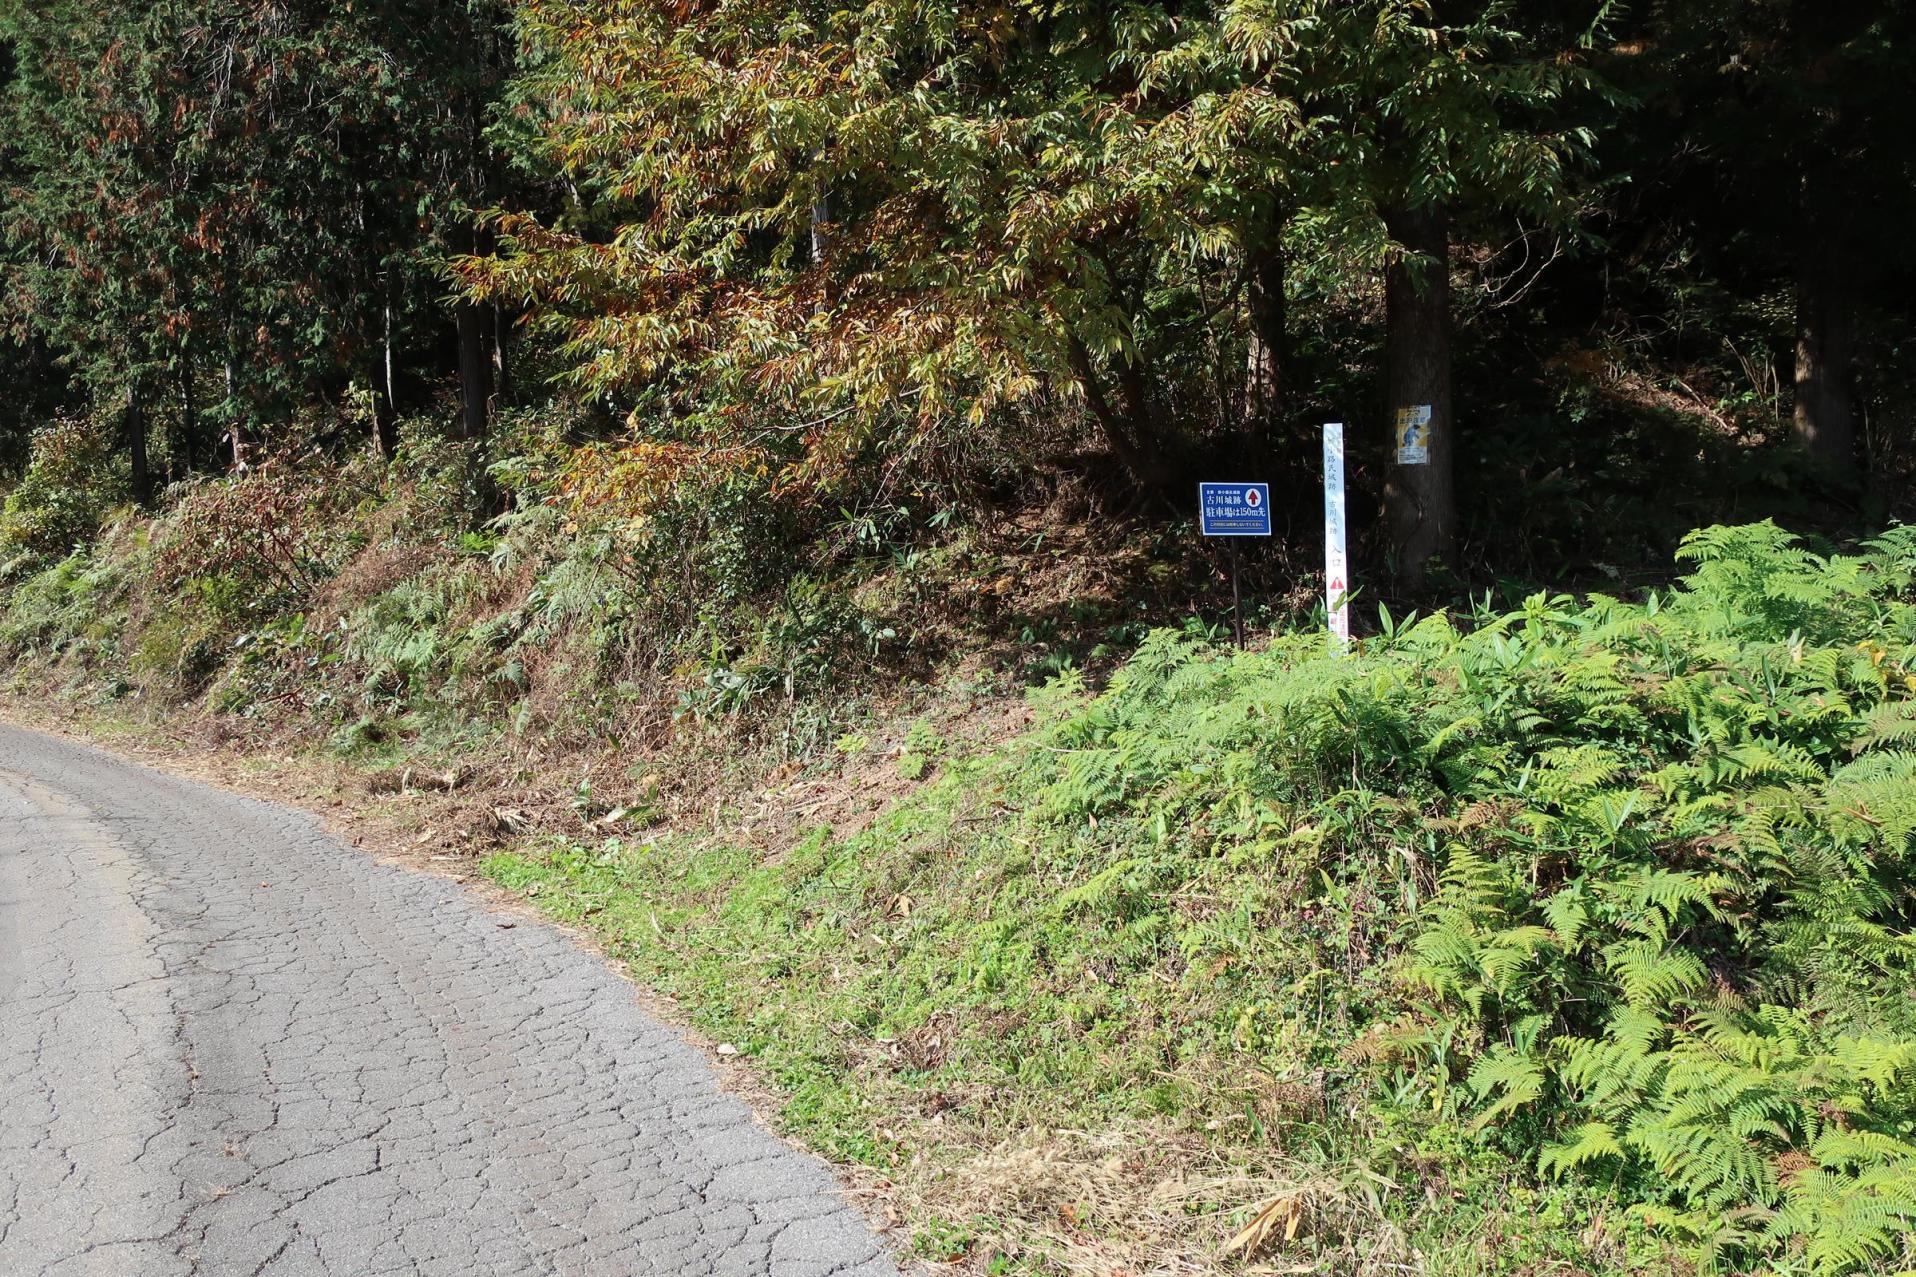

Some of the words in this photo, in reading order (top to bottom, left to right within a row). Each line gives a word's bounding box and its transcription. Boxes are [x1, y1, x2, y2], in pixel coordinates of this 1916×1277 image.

[1207, 495, 1242, 505] 古川城跡
[1206, 507, 1266, 518] 駐車場は150m先
